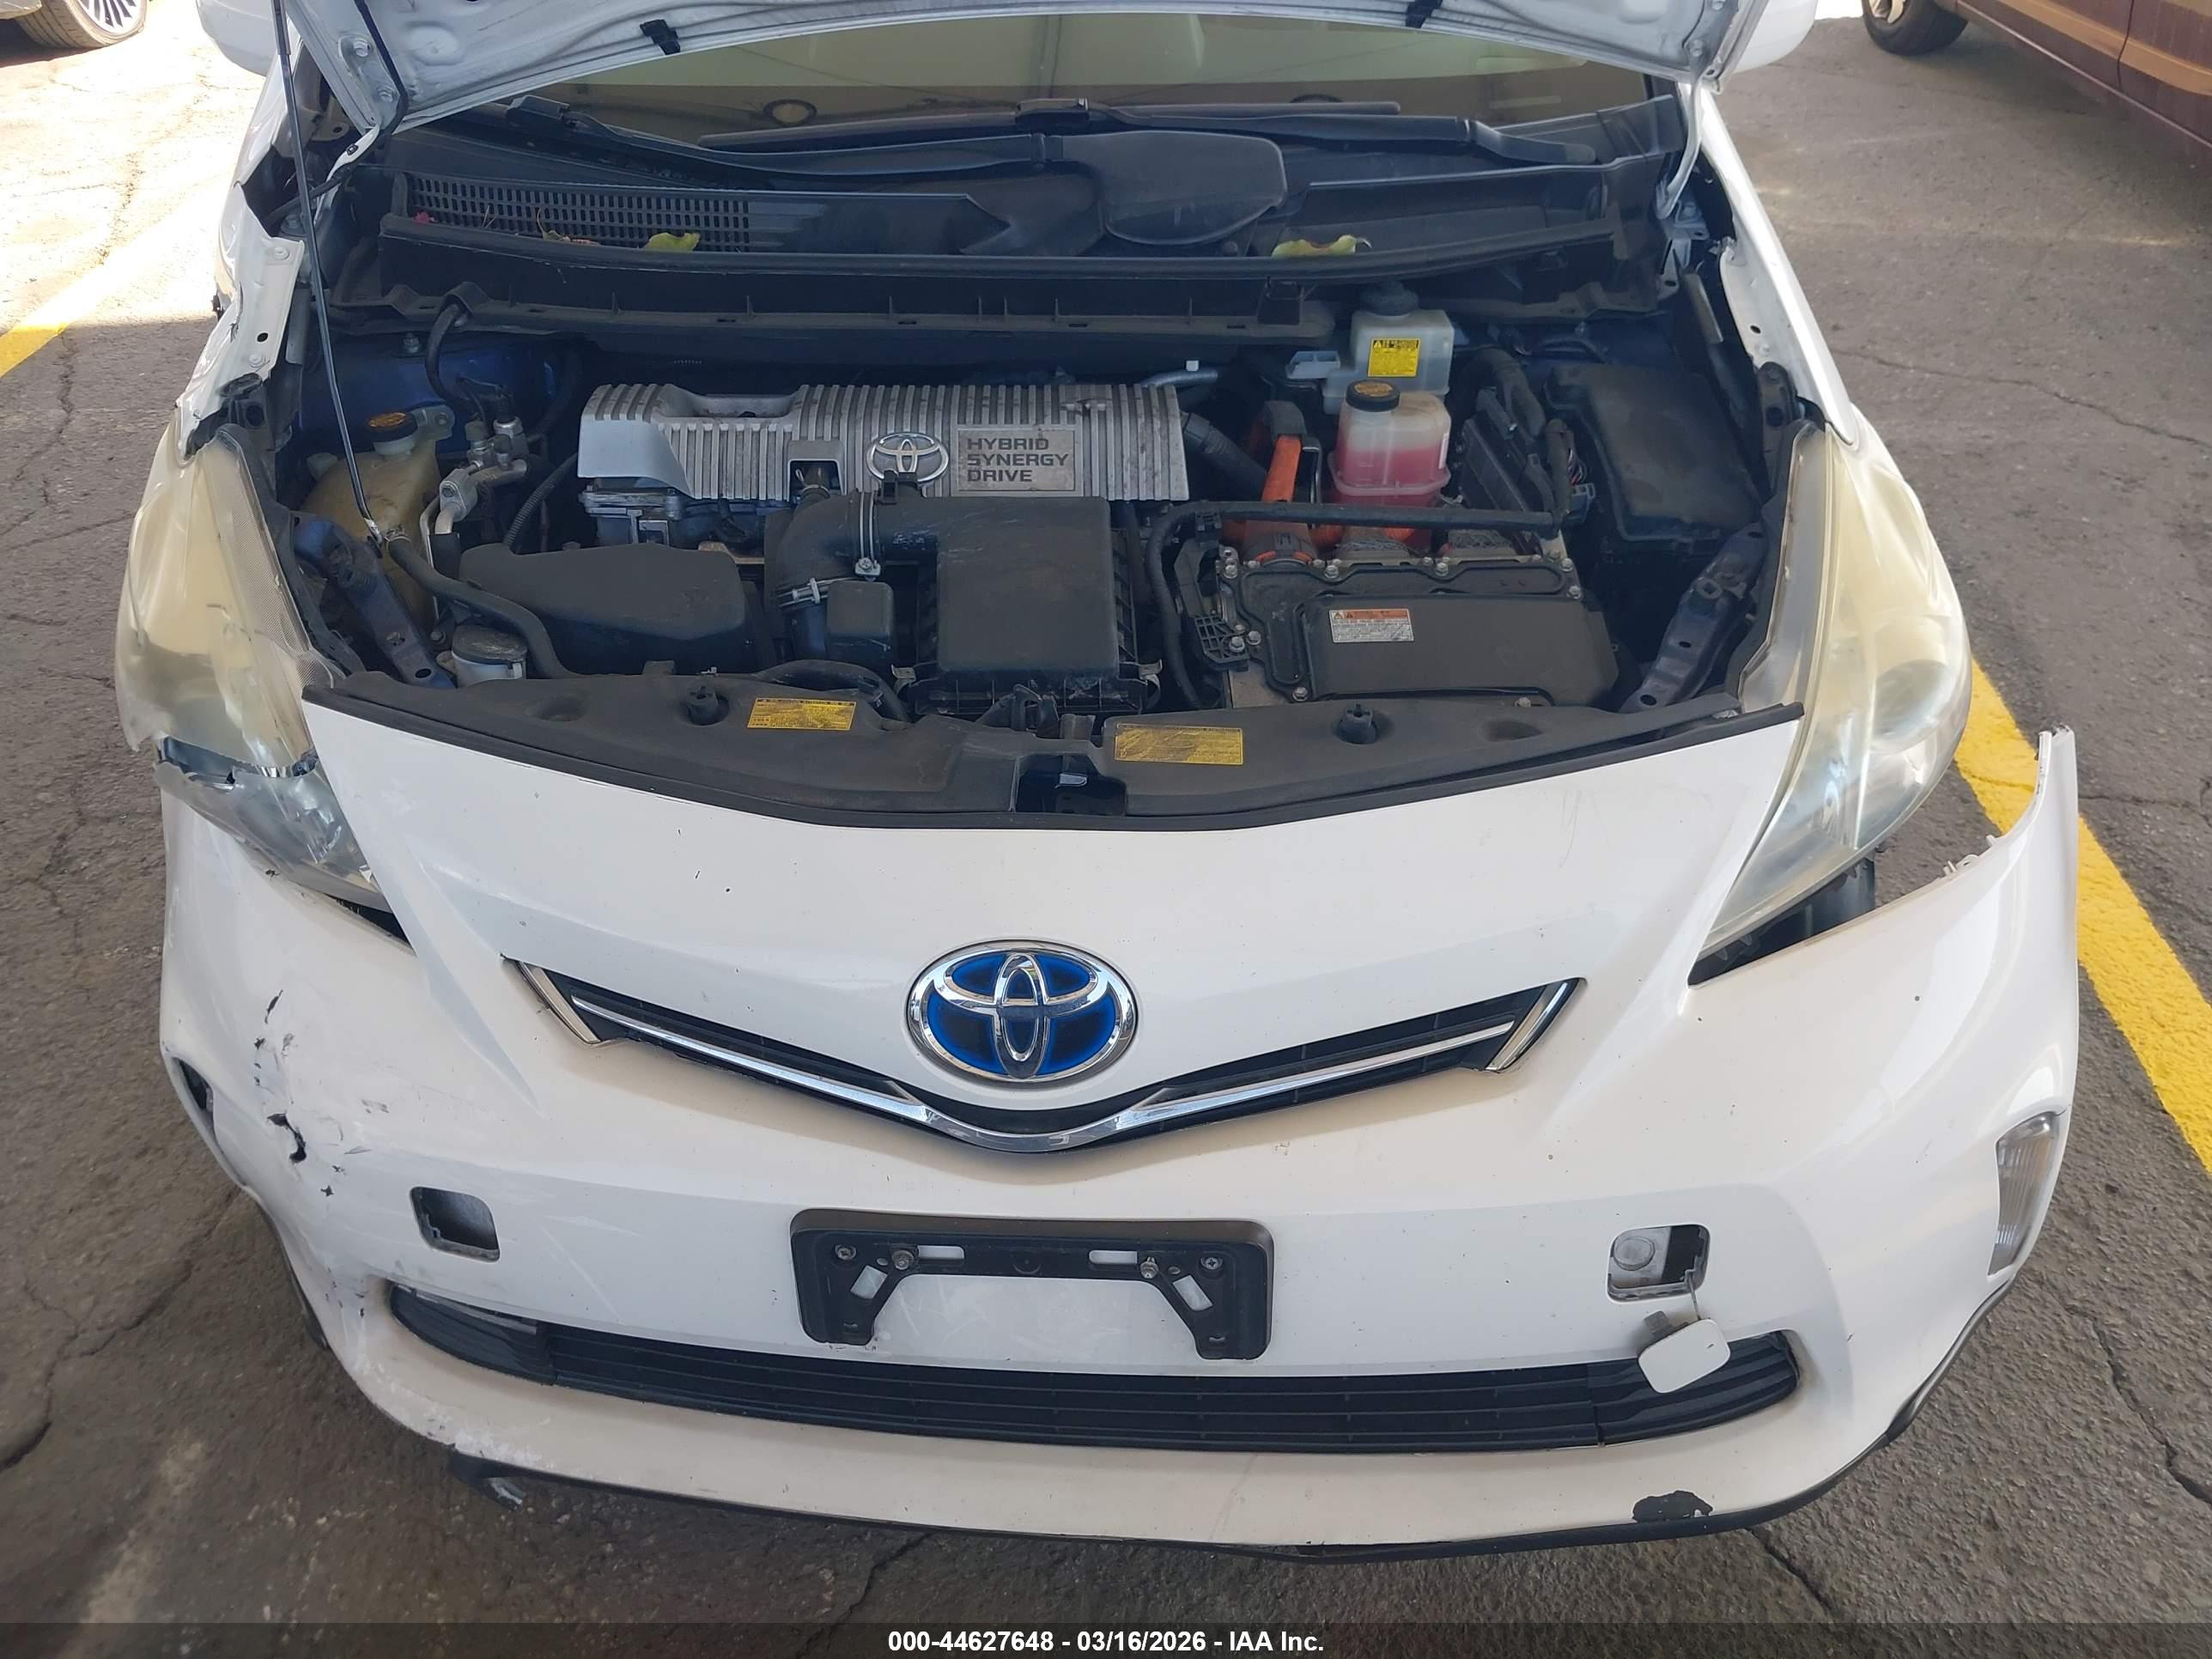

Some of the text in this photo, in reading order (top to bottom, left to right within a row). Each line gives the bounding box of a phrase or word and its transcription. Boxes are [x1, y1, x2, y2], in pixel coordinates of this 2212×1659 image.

[967, 438, 1048, 450] HYBRID
[967, 453, 1068, 466] SYNERGY
[967, 470, 1032, 482] DRIVE
